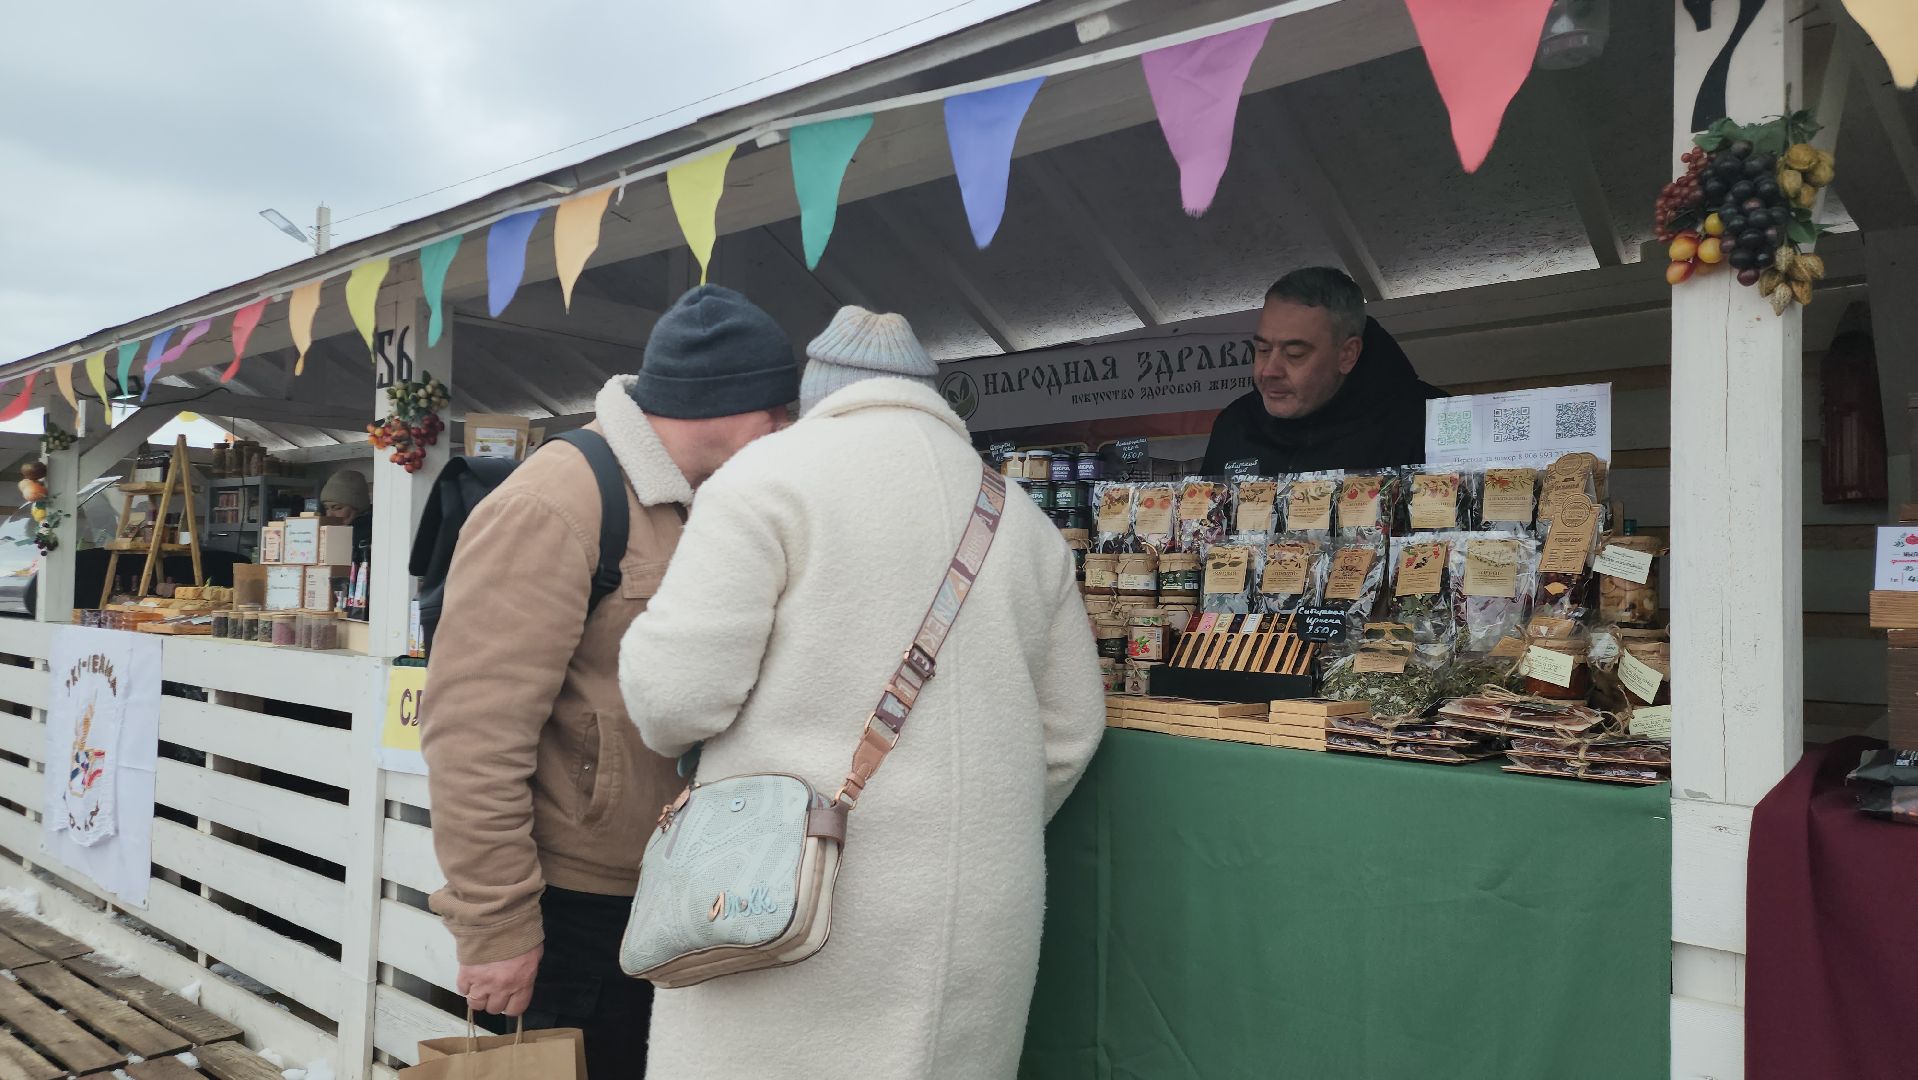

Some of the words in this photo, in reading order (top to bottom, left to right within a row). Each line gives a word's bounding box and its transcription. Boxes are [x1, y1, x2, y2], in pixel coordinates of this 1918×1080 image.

[376, 325, 413, 389] 56
[983, 355, 1120, 397] НАРОДНАЯ
[1071, 388, 1135, 406] ИСКУССТВО
[1140, 379, 1201, 400] ЗДОРОВОЙ
